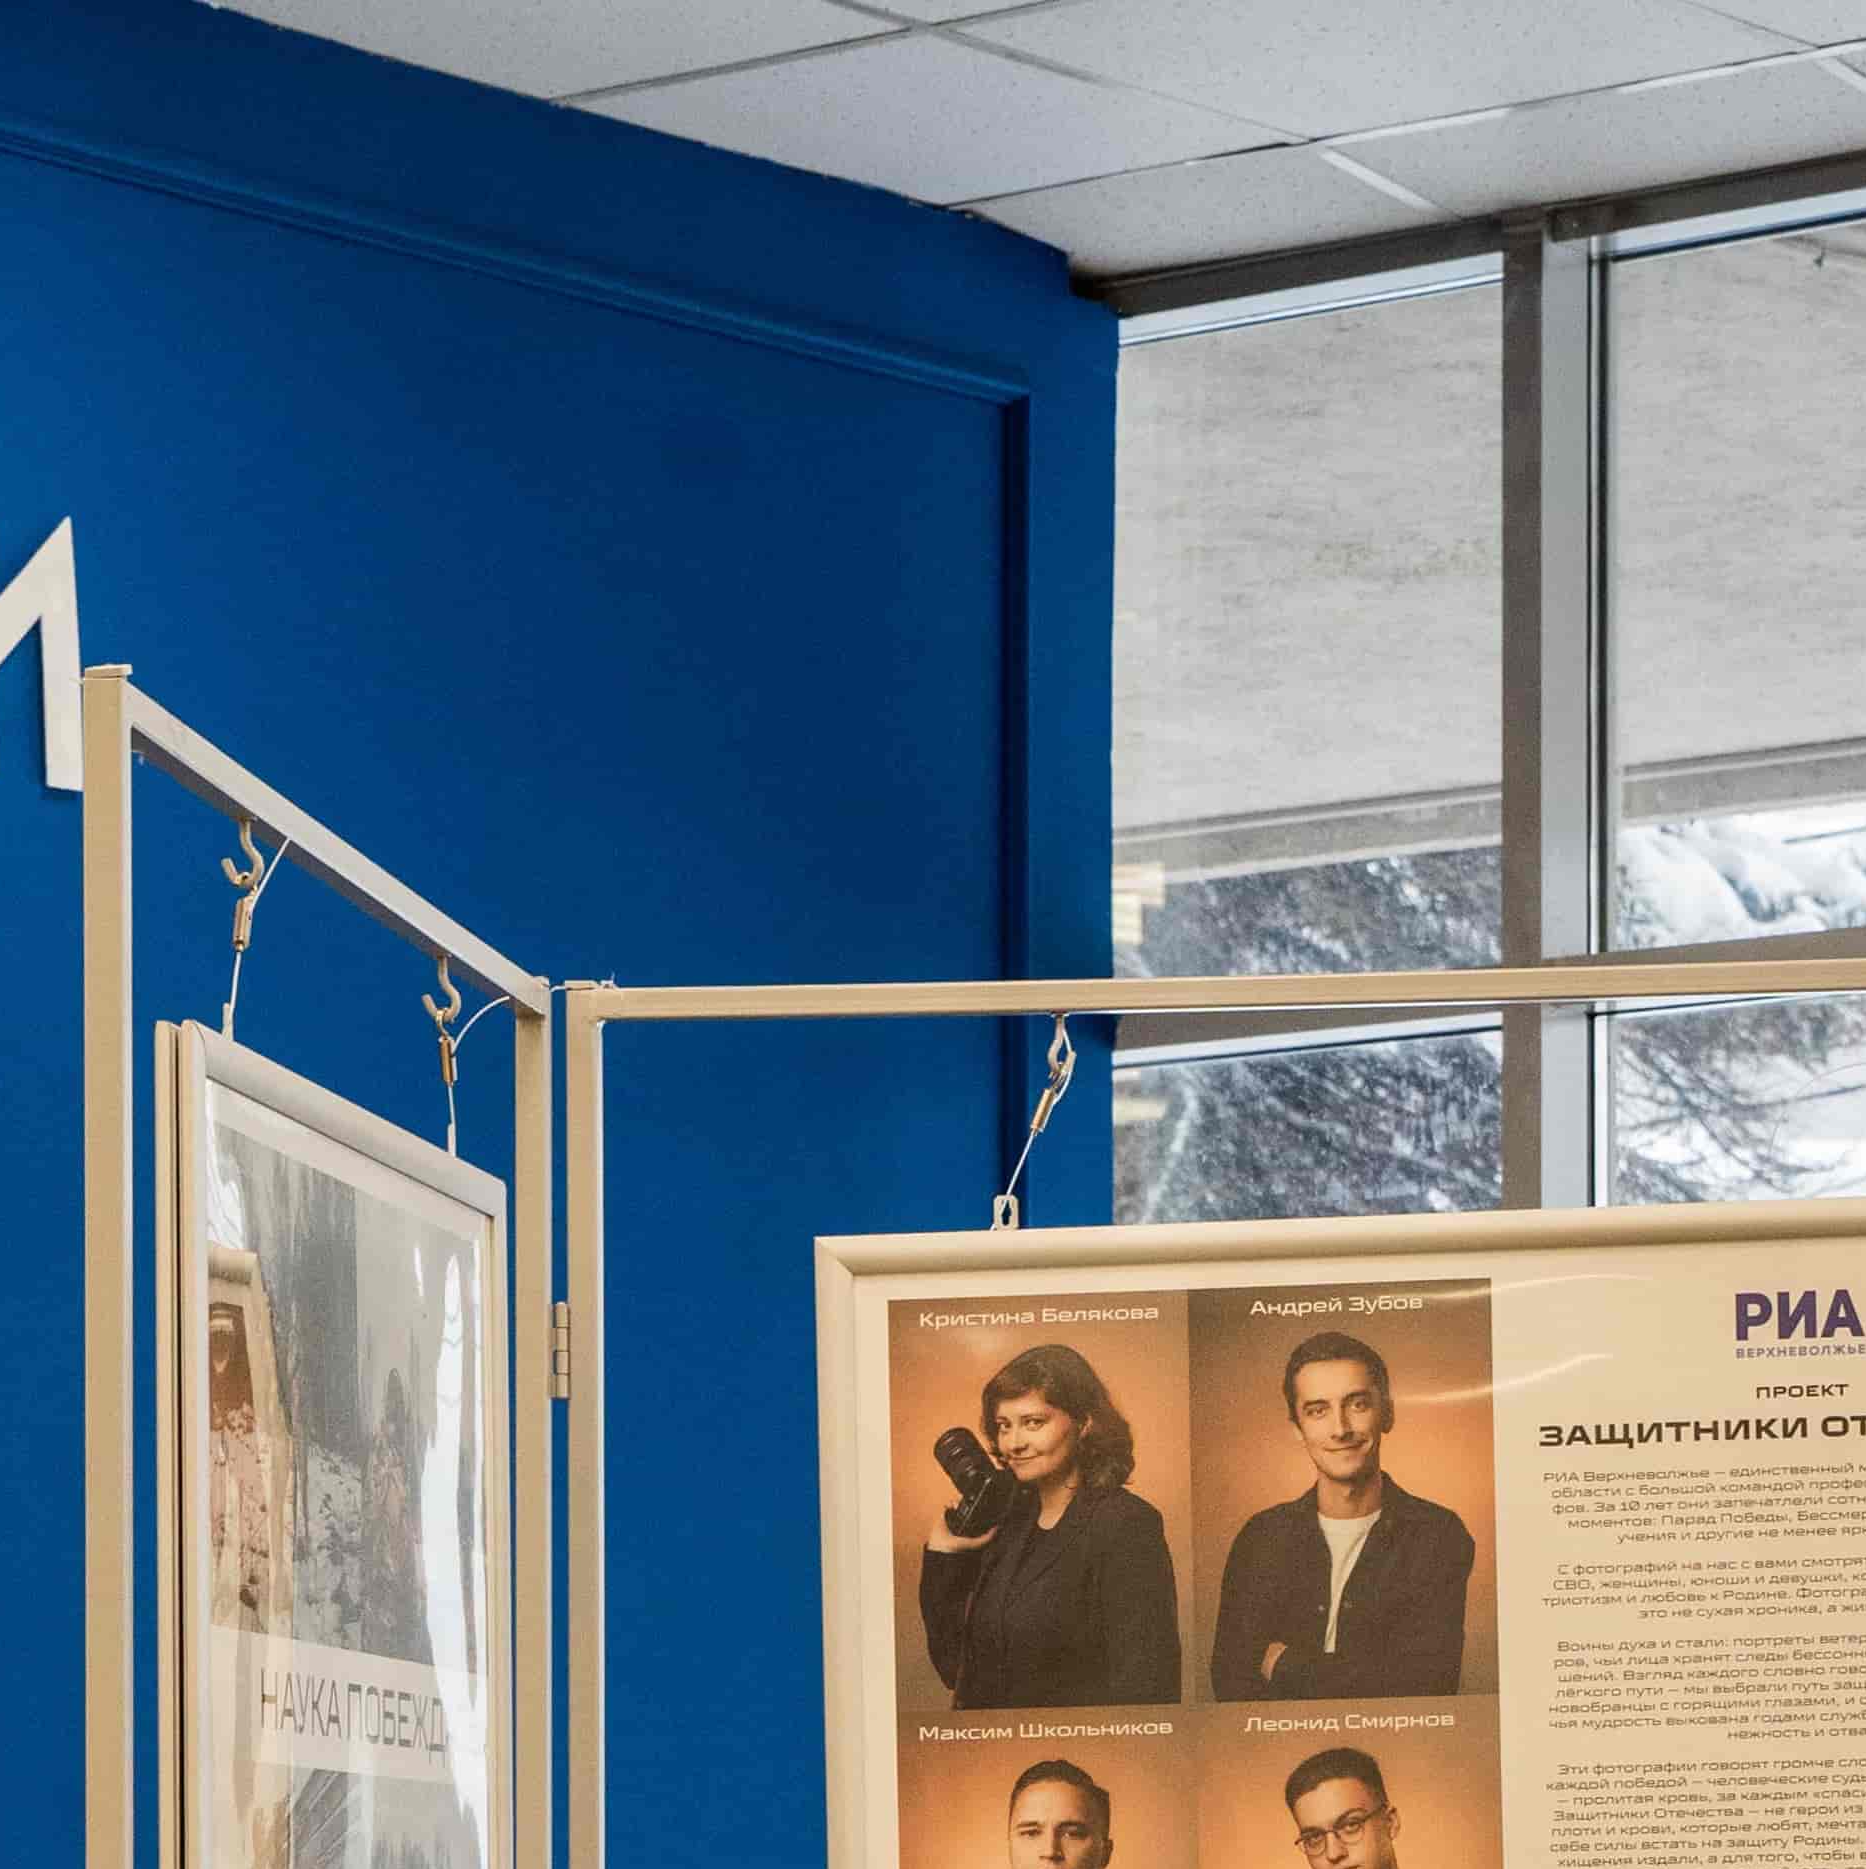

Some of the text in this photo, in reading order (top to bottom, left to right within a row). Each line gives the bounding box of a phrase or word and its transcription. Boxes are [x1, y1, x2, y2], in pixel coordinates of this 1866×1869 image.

[1250, 1293, 1424, 1318] Андрей Зубов
[1735, 1288, 1866, 1341] РИА
[919, 1303, 1159, 1330] Кристина Белякова
[1735, 1343, 1866, 1359] ВЕРХНЕВОЛЖЬЕ
[1755, 1383, 1850, 1399] ПРОЕКТ
[1539, 1416, 1808, 1449] ЗАЩИТНИКИ
[1543, 1471, 1579, 1482] РИА
[1583, 1468, 1709, 1482] Верхневолжье
[1729, 1464, 1853, 1477] единственный
[1551, 1487, 1621, 1498] области
[1625, 1487, 1634, 1496] с
[1639, 1484, 1715, 1495] большой
[1720, 1479, 1804, 1493] командой
[1552, 1503, 1589, 1515] фов.
[1594, 1501, 1615, 1512] За
[1620, 1500, 1640, 1511] 10
[1644, 1501, 1673, 1510] лет
[1677, 1500, 1709, 1509] они
[1714, 1496, 1823, 1508] запечатлели
[1568, 1517, 1655, 1528] моментов:
[1661, 1513, 1716, 1526] Парад
[1720, 1510, 1791, 1524] Победы,
[1617, 1532, 1676, 1544] учения
[1681, 1532, 1690, 1540] и
[1695, 1529, 1753, 1541] другие
[1758, 1528, 1778, 1538] не
[1783, 1527, 1837, 1537] менее
[1557, 1565, 1568, 1575] С
[1573, 1562, 1677, 1575] фотографий
[1681, 1562, 1701, 1570] на
[1706, 1561, 1736, 1570] нас
[1740, 1560, 1749, 1569] с
[1754, 1559, 1797, 1568] вами
[1553, 1578, 1594, 1591] СВО,
[1600, 1579, 1685, 1589] женщины,
[1690, 1576, 1749, 1586] юноши
[1755, 1575, 1764, 1584] и
[1768, 1573, 1847, 1586] девушки,
[1542, 1595, 1621, 1606] триотизм
[1626, 1595, 1636, 1603] и
[1640, 1592, 1706, 1603] любовь
[1710, 1592, 1718, 1600] к
[1723, 1588, 1790, 1601] Родине.
[1639, 1609, 1667, 1618] это
[1671, 1609, 1692, 1618] не
[1696, 1607, 1743, 1617] сухая
[1747, 1604, 1821, 1616] хроника,
[1826, 1604, 1836, 1613] а
[1557, 1639, 1613, 1652] Воины
[1618, 1640, 1656, 1650] духа
[1661, 1640, 1670, 1648] и
[1675, 1638, 1727, 1648] стали:
[1733, 1635, 1814, 1648] портреты
[1554, 1658, 1588, 1669] ров,
[1593, 1657, 1622, 1666] чьи
[1627, 1656, 1669, 1665] лица
[1673, 1653, 1731, 1664] хранят
[1735, 1652, 1788, 1662] следы
[1558, 1673, 1615, 1682] шений.
[1623, 1668, 1683, 1681] Взгляд
[1687, 1668, 1759, 1679] каждого
[1763, 1666, 1825, 1676] словно
[261, 1668, 451, 1768] НАУКА ПОБЕЖД
[1244, 1712, 1454, 1732] Леонид Смирнов
[919, 1720, 1173, 1740] Максим Школьников
[1727, 1728, 1810, 1739] нежность
[1814, 1728, 1824, 1736] и
[1558, 1766, 1588, 1775] Эти
[1592, 1762, 1696, 1775] фотографии
[1701, 1760, 1768, 1771] говорят
[1773, 1758, 1834, 1769] громче
